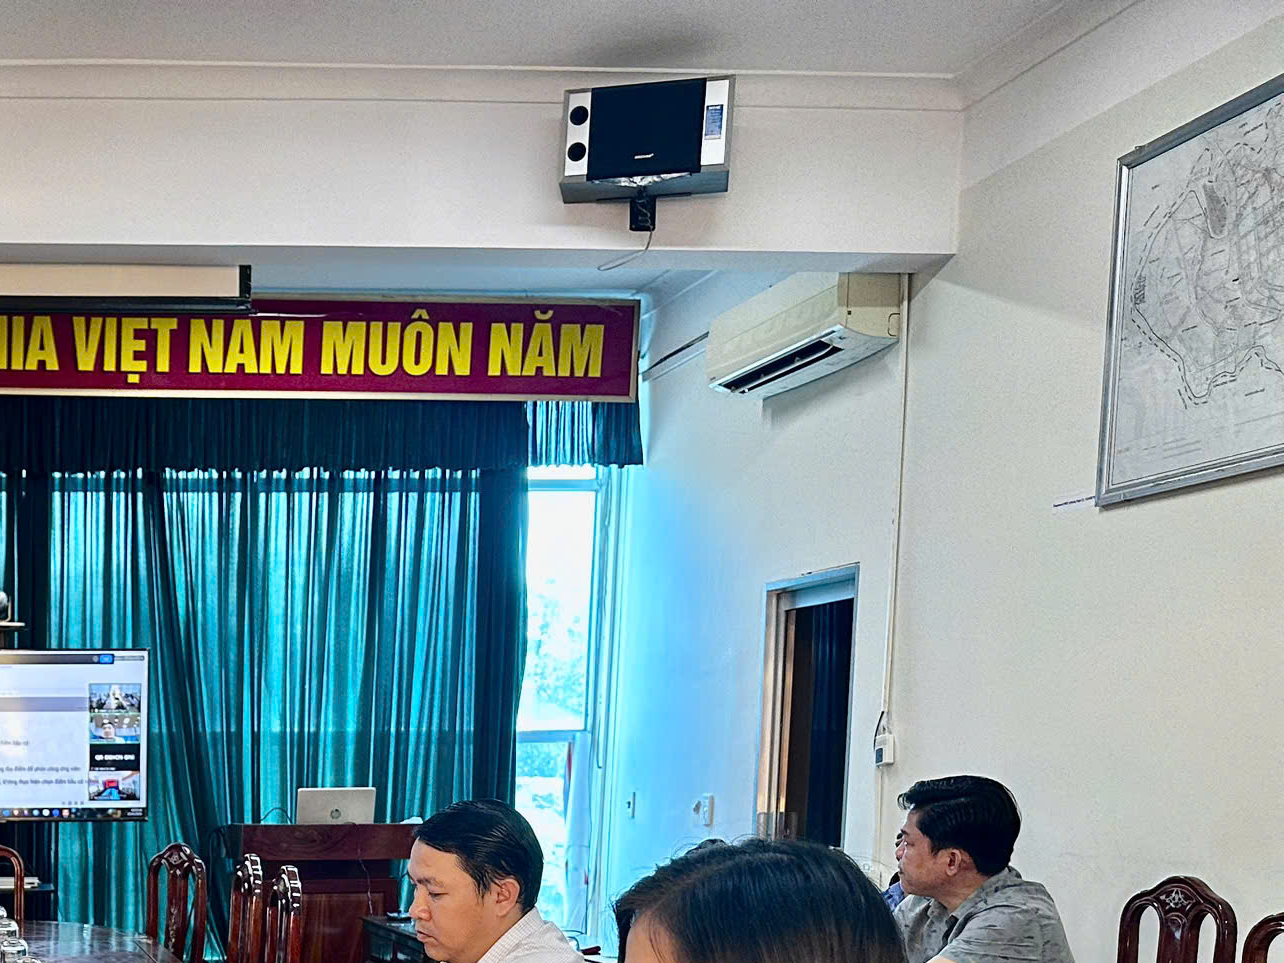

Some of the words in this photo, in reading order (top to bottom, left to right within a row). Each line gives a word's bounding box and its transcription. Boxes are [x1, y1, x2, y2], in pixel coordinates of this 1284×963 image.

[187, 318, 305, 375] NAM
[320, 308, 473, 377] MUÔN
[487, 309, 605, 378] NĂM
